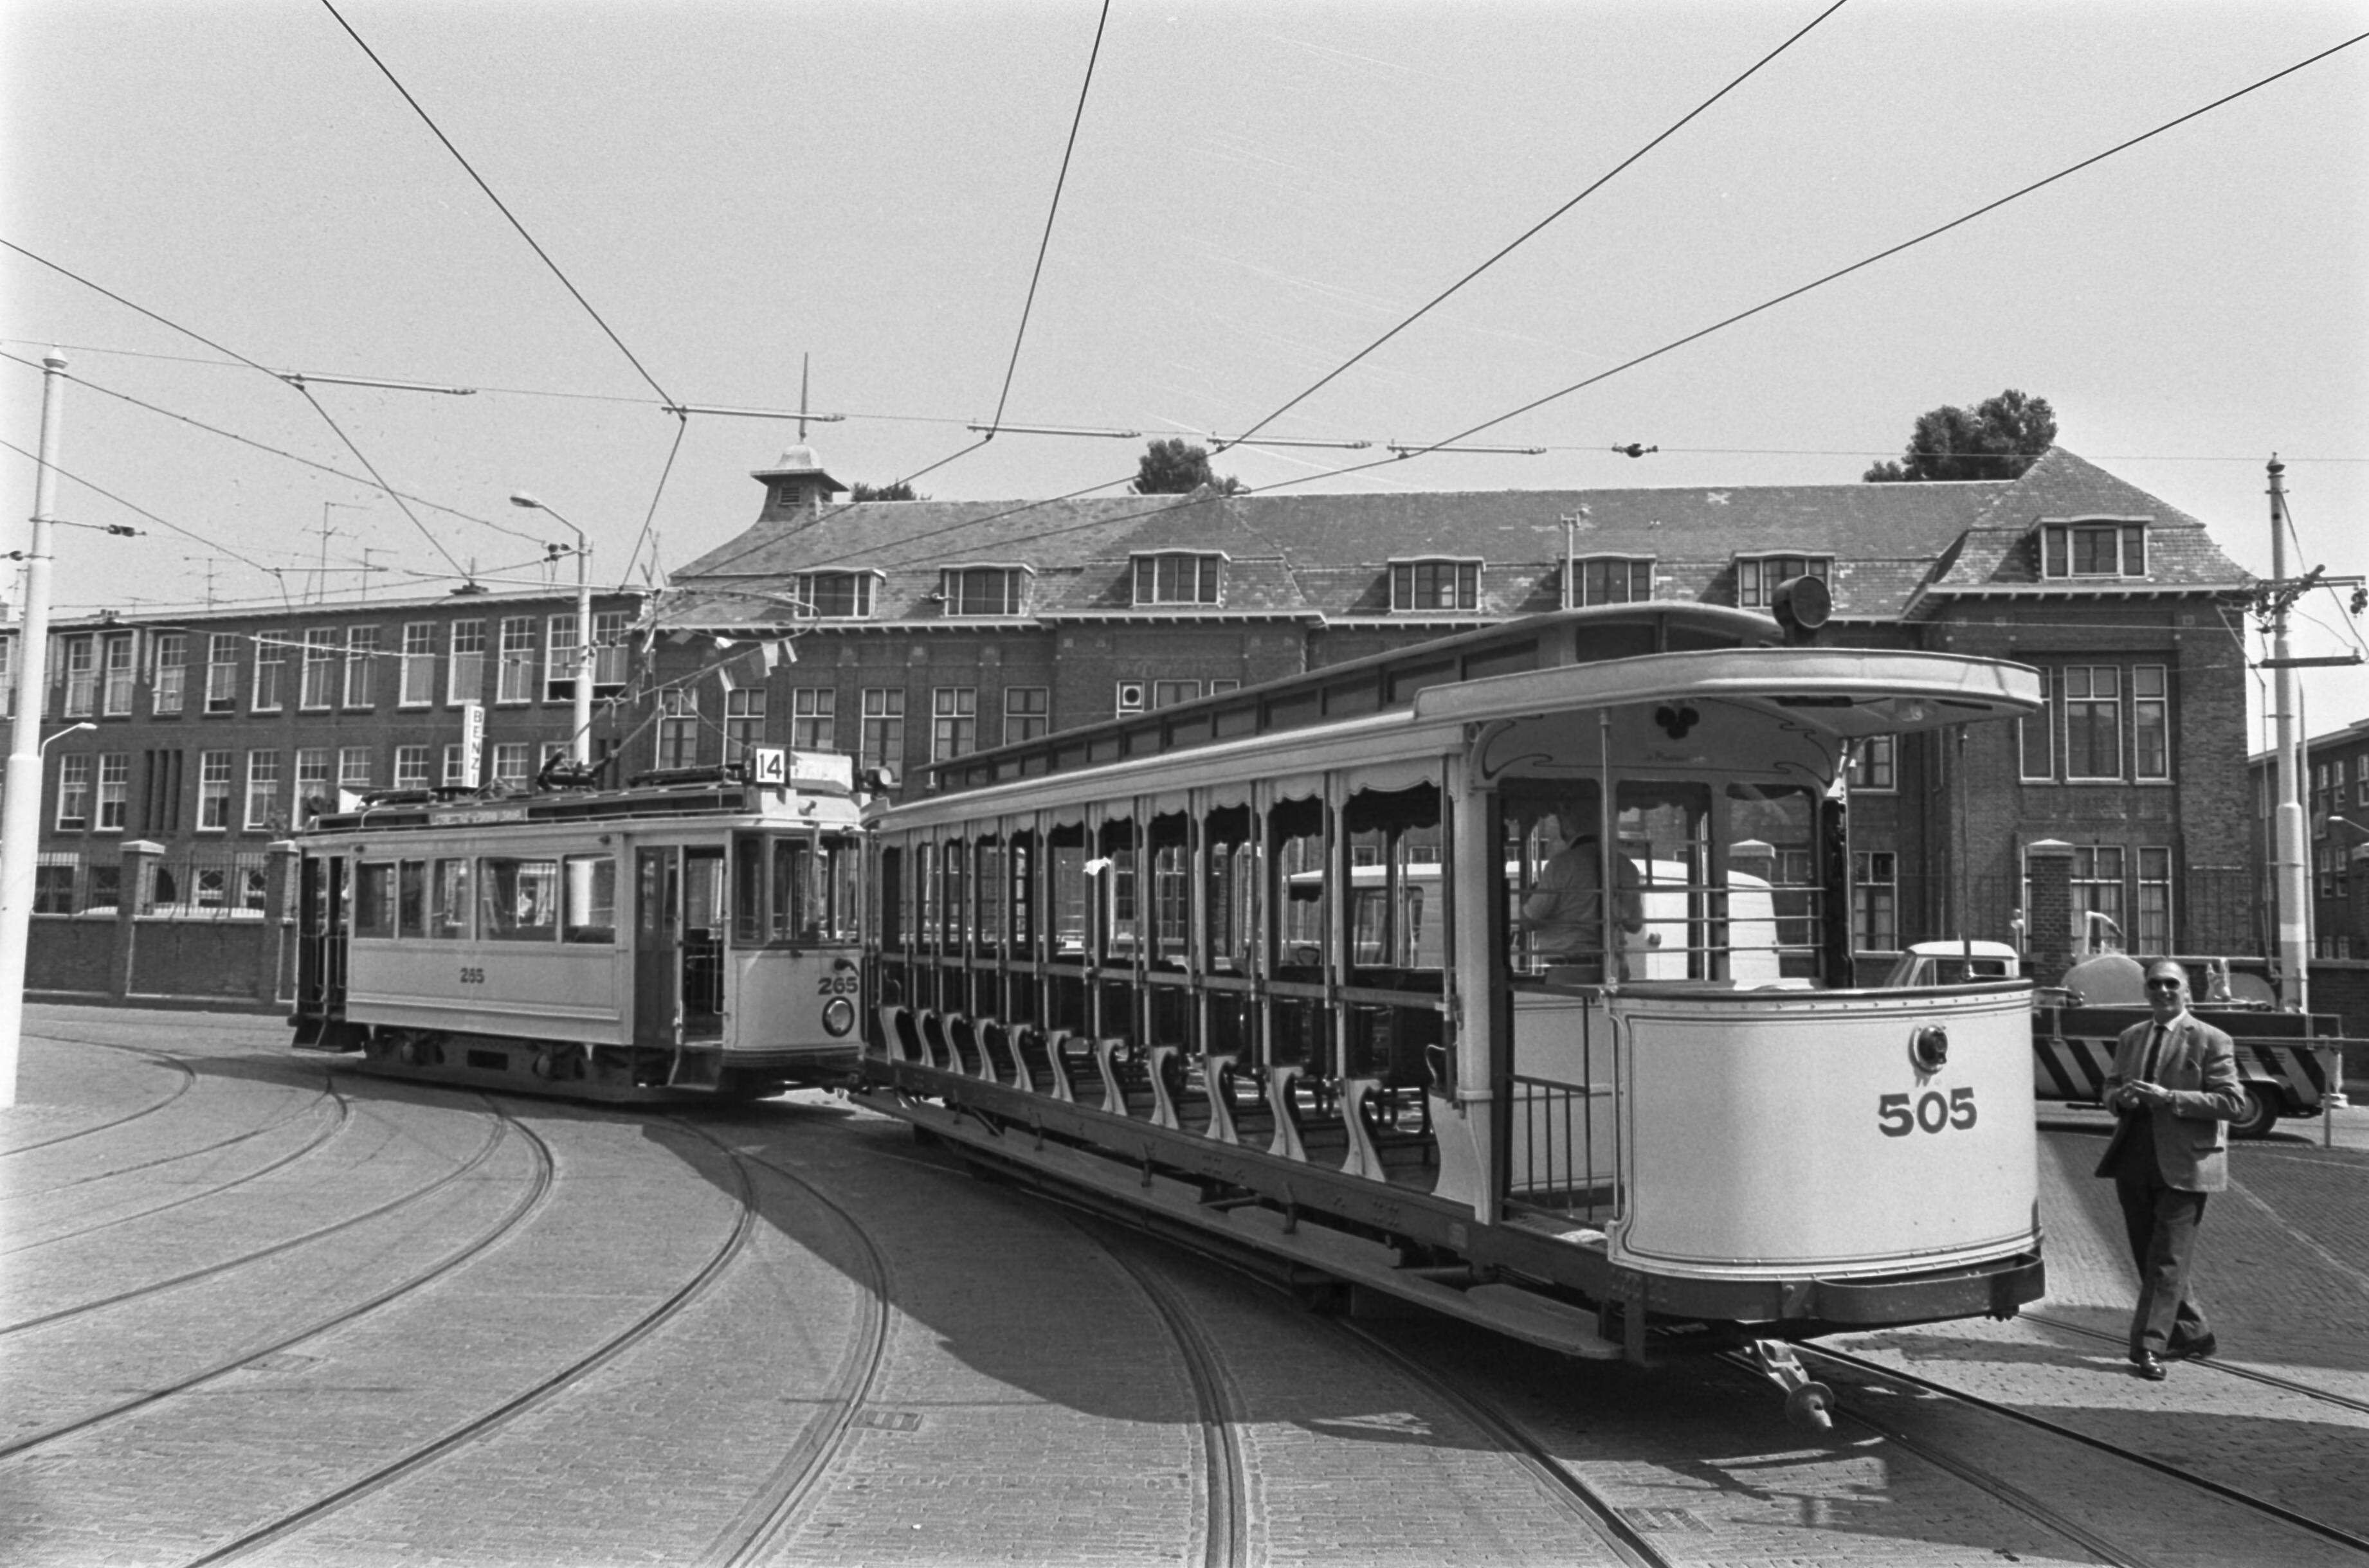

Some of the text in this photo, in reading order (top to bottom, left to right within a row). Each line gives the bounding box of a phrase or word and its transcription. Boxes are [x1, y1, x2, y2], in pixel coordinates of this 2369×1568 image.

[759, 753, 782, 779] 14
[460, 967, 485, 984] 265
[818, 977, 858, 995] 265
[1878, 1087, 1977, 1137] 505
